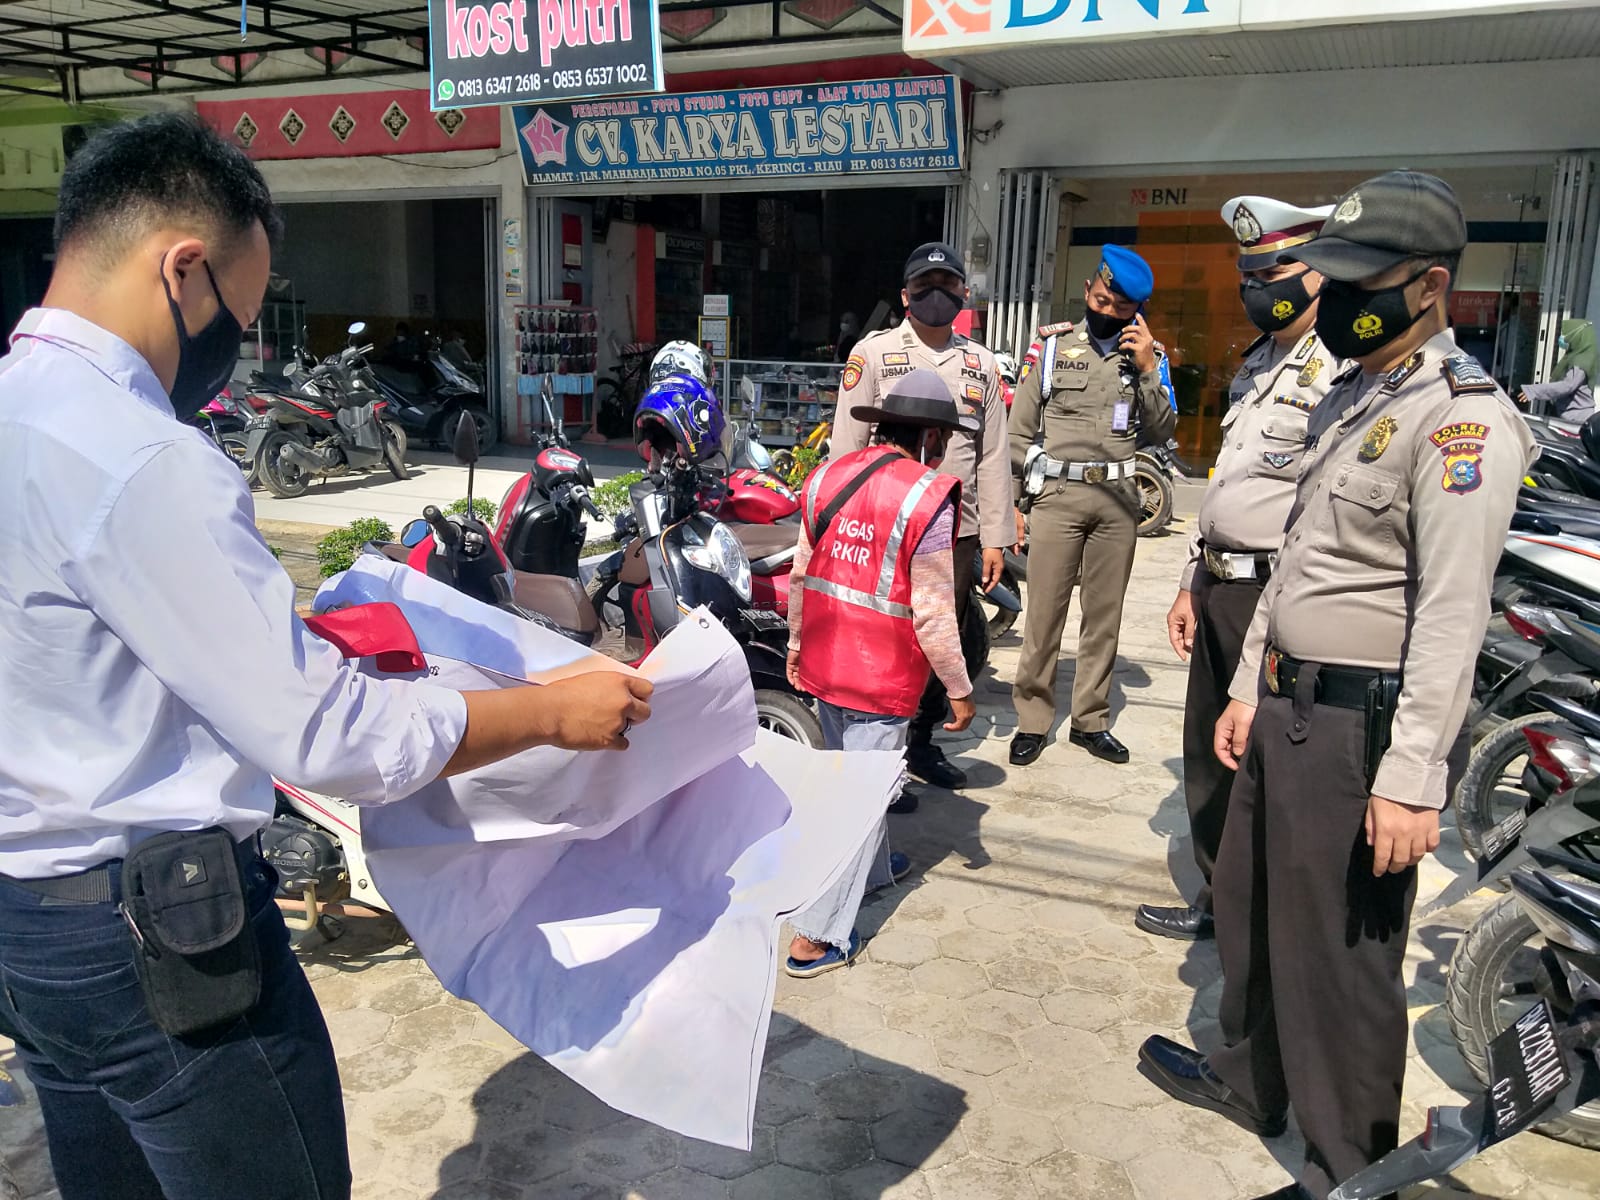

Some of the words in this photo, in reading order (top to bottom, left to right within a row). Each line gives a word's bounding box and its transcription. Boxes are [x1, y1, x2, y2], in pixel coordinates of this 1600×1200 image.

[446, 0, 528, 59] kost
[458, 81, 482, 97] 0813
[485, 77, 512, 95] 6347
[515, 73, 541, 92] 2618
[553, 69, 582, 88] 0853
[585, 67, 613, 86] 6537
[616, 64, 647, 83] 1002
[652, 98, 680, 112] FOTO
[684, 95, 726, 111] STUDIO
[738, 92, 768, 107] FOTO
[772, 90, 803, 105] COPY
[817, 86, 848, 102] ALAT
[852, 83, 890, 99] TULIS
[895, 80, 946, 96] KANTOR
[575, 119, 629, 166] CV.
[630, 111, 766, 163] KARYA
[770, 99, 950, 158] LESTARI
[532, 171, 574, 184] ALAMAT
[581, 170, 600, 183] JLN.
[602, 167, 658, 182] MAHARAJA
[659, 166, 694, 178] INDRA
[696, 163, 726, 177] NO.05
[756, 161, 806, 174] KERINCI
[814, 160, 843, 172] RIAU
[850, 159, 869, 171] HP.
[871, 158, 897, 170] 0813
[899, 156, 925, 168] 6347
[928, 155, 955, 166] 2618
[1151, 188, 1188, 205] BNI
[1359, 328, 1384, 340] POLRI
[881, 366, 917, 378] USMA
[1055, 360, 1090, 371] RIADI
[1433, 424, 1486, 440] POLRES
[1449, 443, 1476, 452] RIAU
[836, 516, 875, 542] UGAS
[830, 540, 871, 567] RKIR
[1517, 1003, 1546, 1037] BM
[1519, 1023, 1560, 1072] 2293
[1528, 1058, 1564, 1103] AAR
